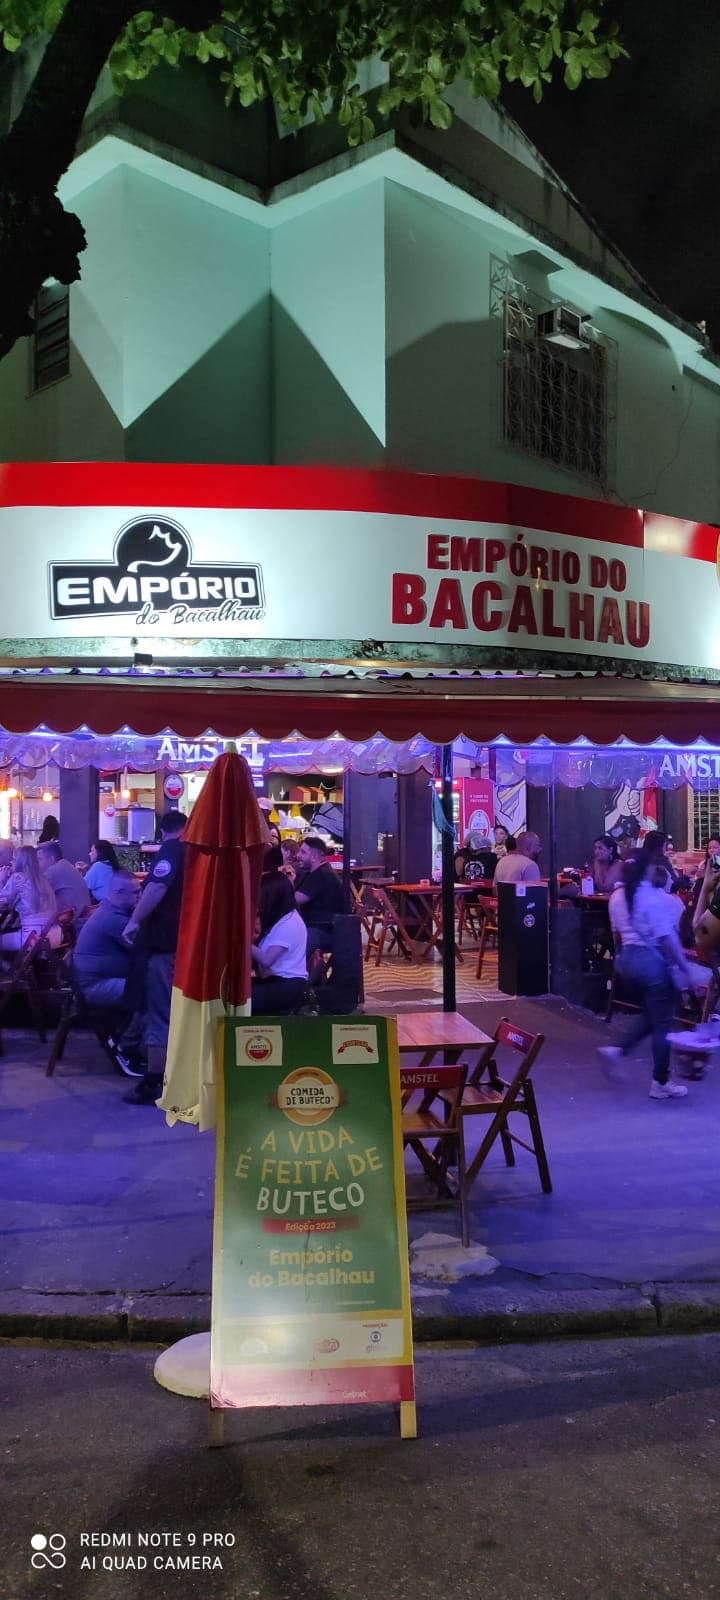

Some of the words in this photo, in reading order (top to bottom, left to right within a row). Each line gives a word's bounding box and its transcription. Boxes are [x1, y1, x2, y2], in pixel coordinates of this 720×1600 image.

[427, 534, 580, 585] EMPÓRIO
[590, 554, 627, 593] DO
[57, 573, 257, 606] EMPÓRIO
[135, 602, 161, 626] do
[171, 599, 263, 624] Bacalhau
[392, 574, 651, 647] BACALHAU
[290, 1087, 325, 1096] COMIDA
[400, 1073, 439, 1085] AMSTEL
[286, 1096, 297, 1106] DE
[261, 1128, 277, 1152] A
[289, 1125, 354, 1154] VIDA
[235, 1147, 252, 1179] É
[261, 1159, 341, 1185] FEITA
[347, 1146, 384, 1178] DE
[256, 1182, 365, 1215] BUTECO
[285, 1220, 315, 1233] Edição
[269, 1245, 354, 1271] Empório
[248, 1271, 275, 1288] do
[278, 1267, 376, 1286] Bacalhau
